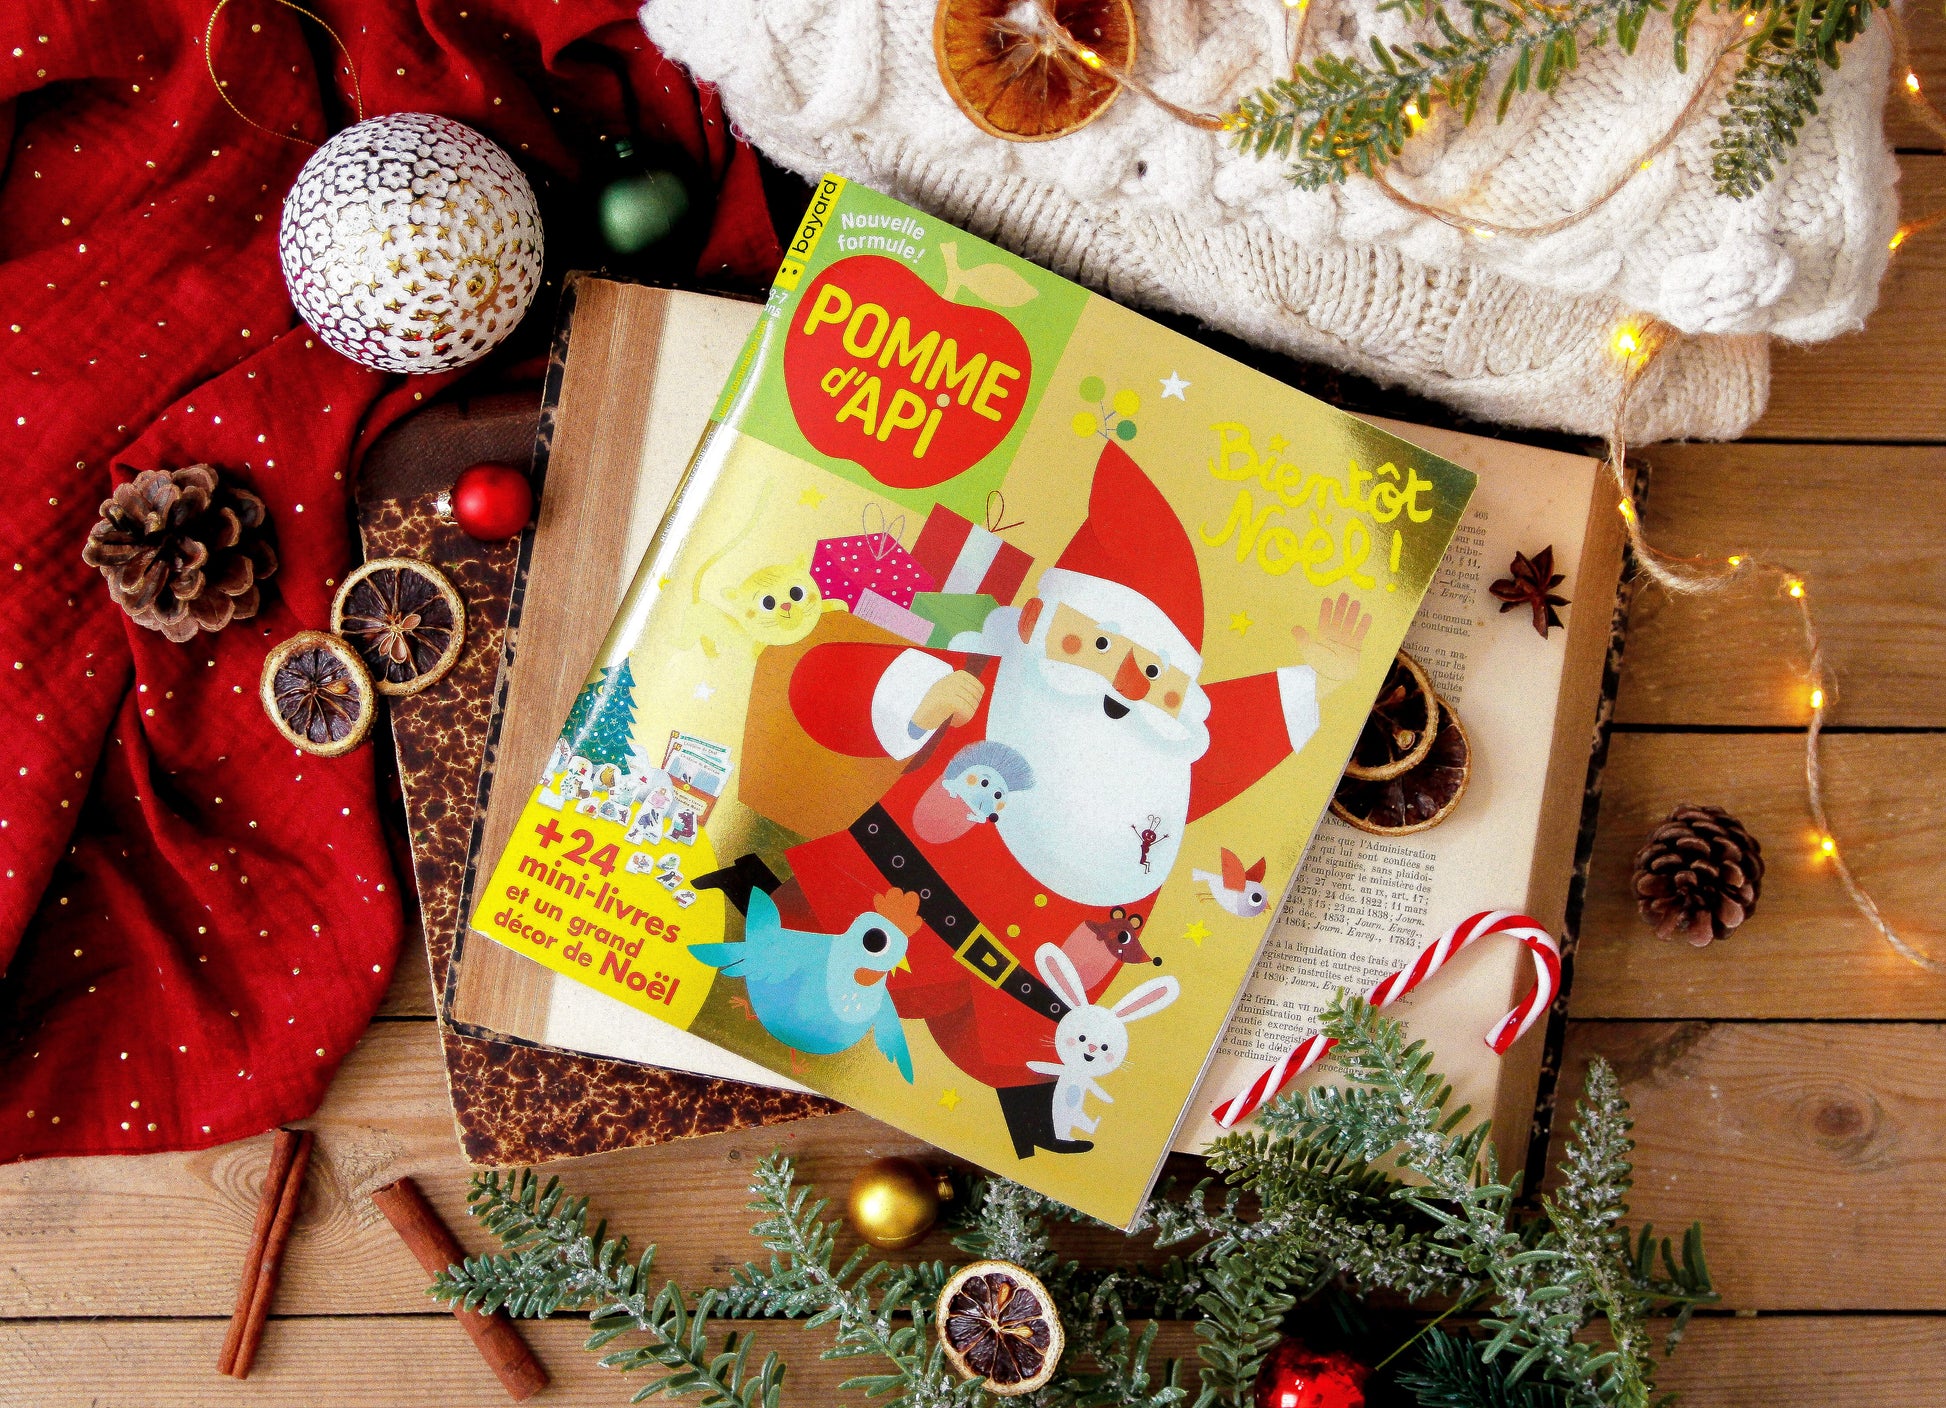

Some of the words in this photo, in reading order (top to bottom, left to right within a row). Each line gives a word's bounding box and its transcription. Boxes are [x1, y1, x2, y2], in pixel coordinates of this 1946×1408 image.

[792, 180, 837, 253] bayard
[841, 212, 925, 241] Nouvelle
[837, 235, 926, 263] formule!
[803, 283, 1021, 422] POMME
[1208, 421, 1433, 523] Bientôt
[1421, 621, 1471, 637] contrainte.
[1432, 613, 1472, 626] commun
[1435, 648, 1446, 656] en
[1433, 669, 1465, 681] quotité
[1320, 845, 1336, 855] qui
[1340, 847, 1352, 857] lui
[1358, 852, 1378, 862] sont
[1383, 856, 1421, 870] confiées
[1425, 864, 1435, 872] se
[1338, 837, 1355, 847] que
[1360, 839, 1436, 861] l'Administration
[1302, 863, 1356, 882] d'employer
[1359, 873, 1367, 882] le
[1370, 876, 1414, 890] ministère
[1416, 884, 1432, 893] des
[1326, 858, 1366, 872] signifiés,
[1371, 866, 1393, 876] sans
[1396, 868, 1433, 882] plaidoi-
[518, 854, 681, 943] mini-livres
[1315, 877, 1326, 887] 27
[1332, 881, 1355, 892] vent.
[1360, 887, 1372, 895] an
[1391, 892, 1409, 901] art.
[1334, 903, 1346, 912] 23
[1347, 906, 1365, 916] mai
[1395, 914, 1426, 927] Journ.
[1339, 893, 1357, 903] déc.
[1404, 905, 1428, 916] mars
[506, 884, 529, 902] et
[534, 897, 564, 922] un
[567, 915, 644, 958] grand
[1283, 905, 1294, 914] 26
[1355, 917, 1385, 931] Journ.
[1314, 922, 1343, 935] Journ.
[494, 908, 557, 949] décor
[563, 941, 592, 967] de
[600, 954, 680, 1006] Noël
[1285, 940, 1293, 950] la
[1296, 942, 1347, 959] liquidation
[1350, 952, 1365, 962] des
[1368, 955, 1389, 967] frais
[1276, 962, 1295, 973] être
[1297, 966, 1341, 982] instruites
[1344, 974, 1353, 982] et
[1320, 960, 1329, 968] et
[1332, 961, 1361, 974] autres
[1290, 976, 1319, 989] Journ.
[1240, 992, 1252, 1002] 22
[1255, 995, 1279, 1007] frim.
[1283, 1000, 1294, 1009] an
[1313, 1005, 1324, 1013] ne
[1268, 1020, 1303, 1034] exercée
[1307, 1015, 1316, 1024] et
[1230, 1036, 1253, 1047] dans
[1256, 1040, 1265, 1049] le
